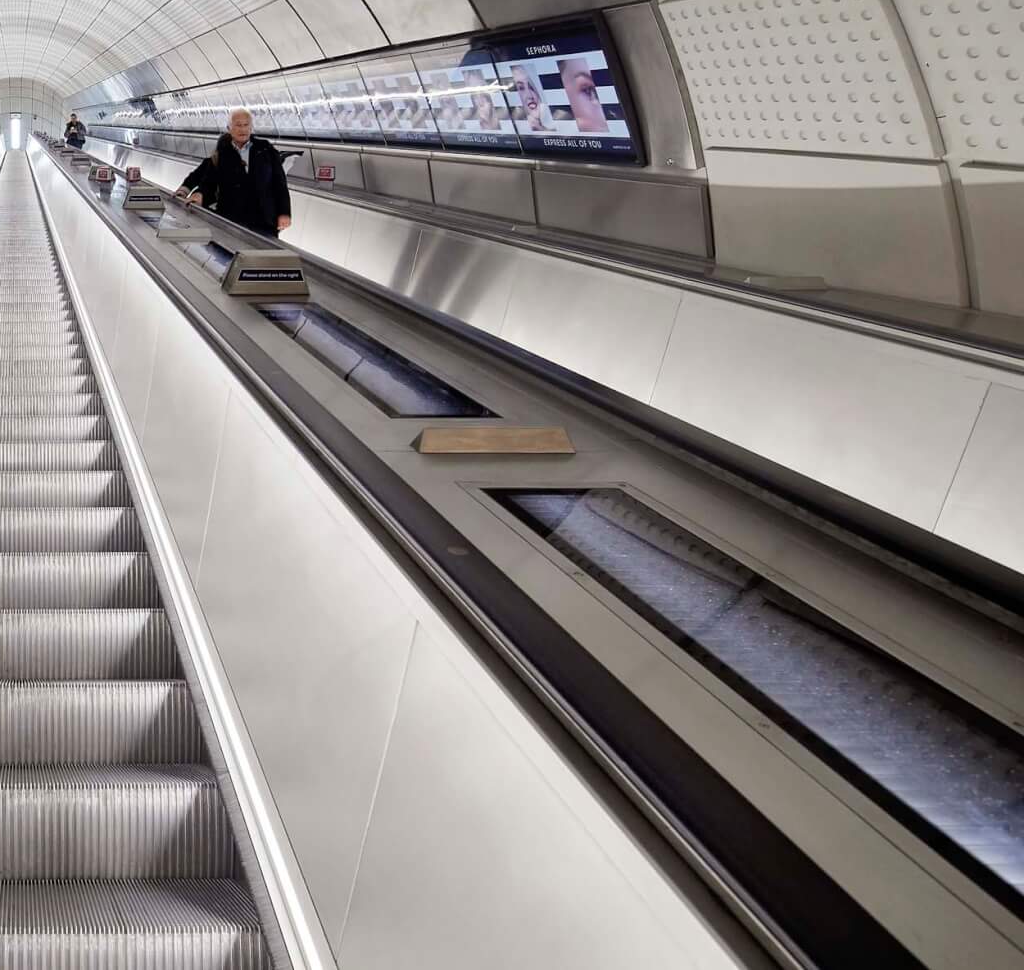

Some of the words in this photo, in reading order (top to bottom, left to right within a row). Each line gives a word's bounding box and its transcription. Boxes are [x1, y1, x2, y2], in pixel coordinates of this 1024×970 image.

[526, 44, 556, 56] SEPHORA
[543, 138, 567, 147] EXPRESS
[567, 140, 578, 148] ALL
[578, 140, 587, 148] OF
[588, 140, 602, 149] YOU
